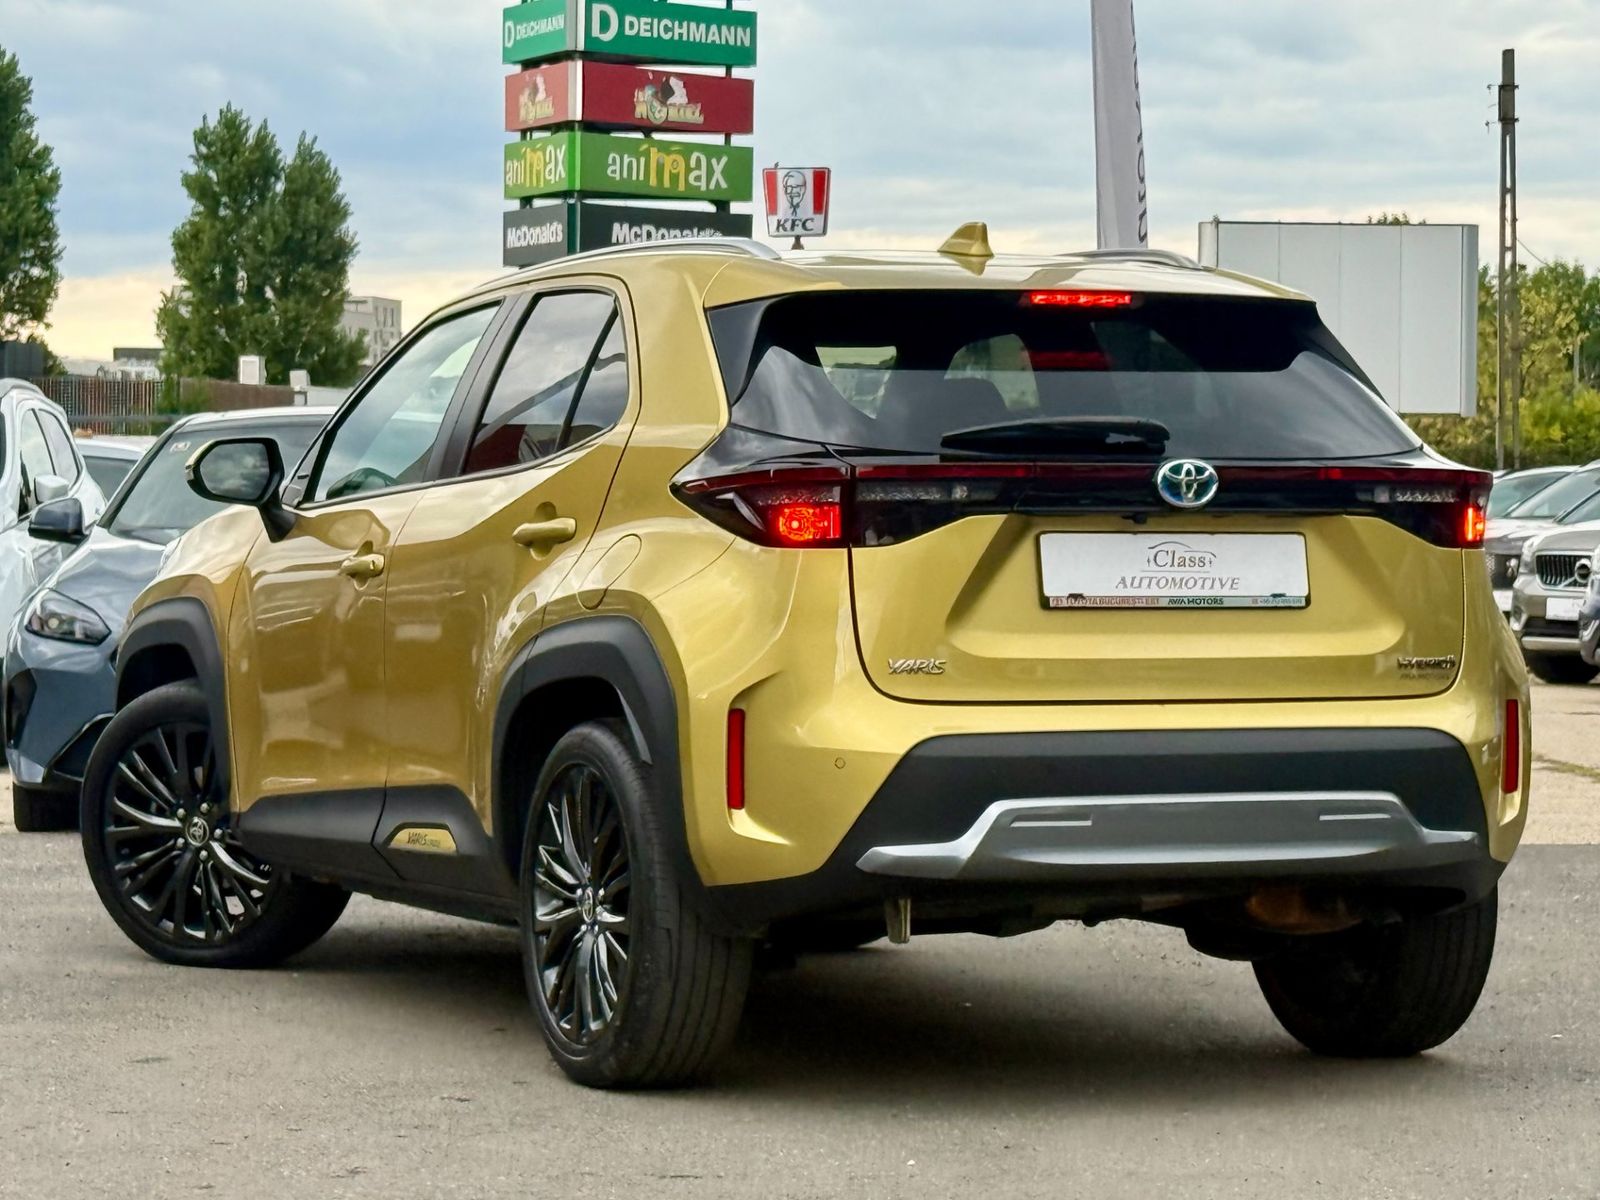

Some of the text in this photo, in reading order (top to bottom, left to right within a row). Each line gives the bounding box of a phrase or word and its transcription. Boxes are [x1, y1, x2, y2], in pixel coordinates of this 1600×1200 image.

[516, 13, 565, 41] DEICHMANN
[624, 14, 751, 47] DEICHMANN
[606, 144, 728, 192] animax
[506, 221, 563, 249] McDonald's
[774, 217, 816, 233] KFC
[1153, 549, 1207, 569] Class
[1114, 575, 1240, 591] AUTOMOTIVE
[1187, 597, 1224, 606] MOTORS
